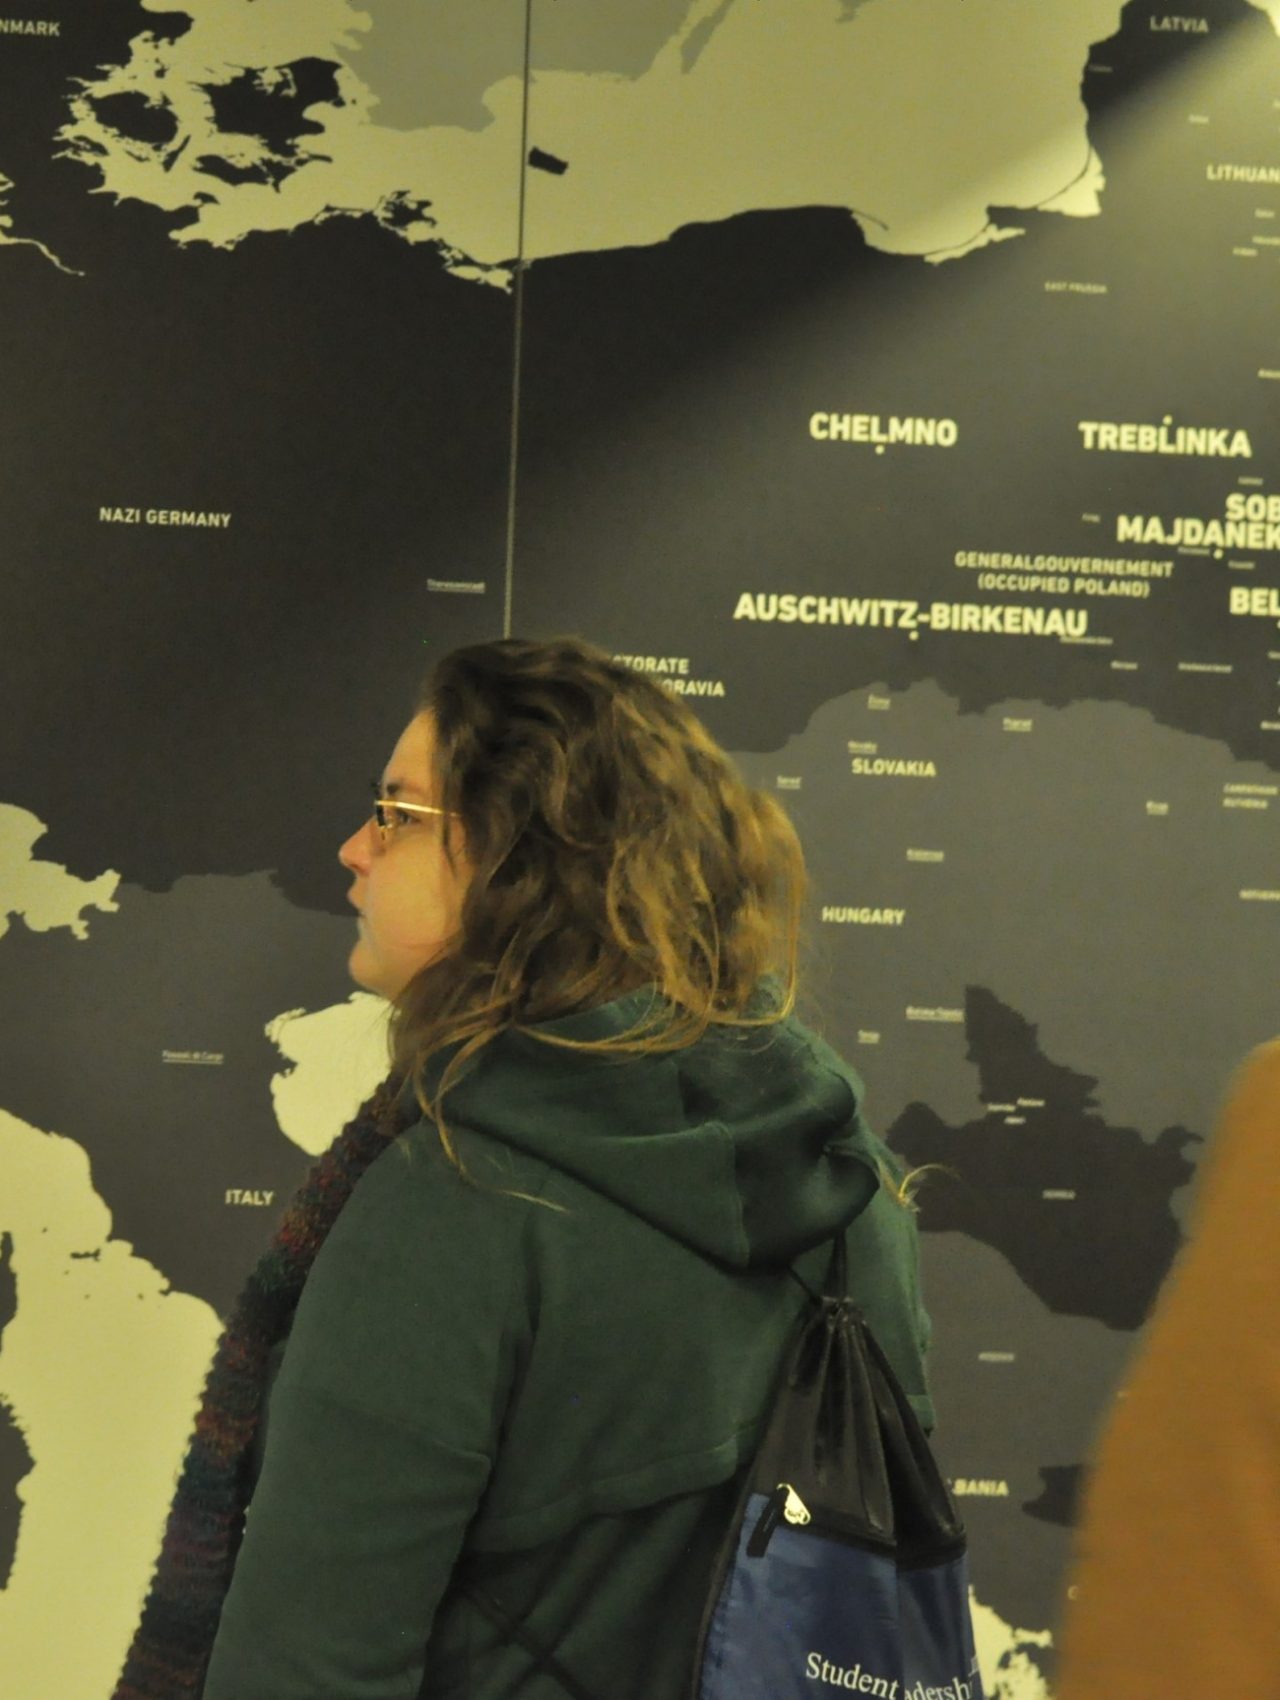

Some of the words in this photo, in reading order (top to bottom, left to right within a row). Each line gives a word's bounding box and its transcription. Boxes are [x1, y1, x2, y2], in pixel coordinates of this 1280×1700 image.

[1150, 16, 1209, 33] LATVIA
[809, 413, 957, 446] CHELMNO
[1078, 422, 1252, 457] TREBLINKA
[99, 507, 141, 524] NAZI
[145, 509, 231, 528] GERMANY
[1117, 514, 1280, 549] MAJDANEK
[955, 552, 1173, 577] GENERALGOUVERNEMENT
[978, 574, 1070, 594] (OCCUPIED
[1073, 580, 1150, 597] POLAND)
[734, 592, 1087, 636] AUSCHWITZ-BIRKENAU
[662, 679, 725, 696] ORAVIA
[852, 758, 936, 777] SLOVAKIA
[822, 906, 905, 925] HUNGARY
[225, 1189, 274, 1206] ITALY
[953, 1479, 1008, 1495] BANIA
[806, 1652, 899, 1700] Student
